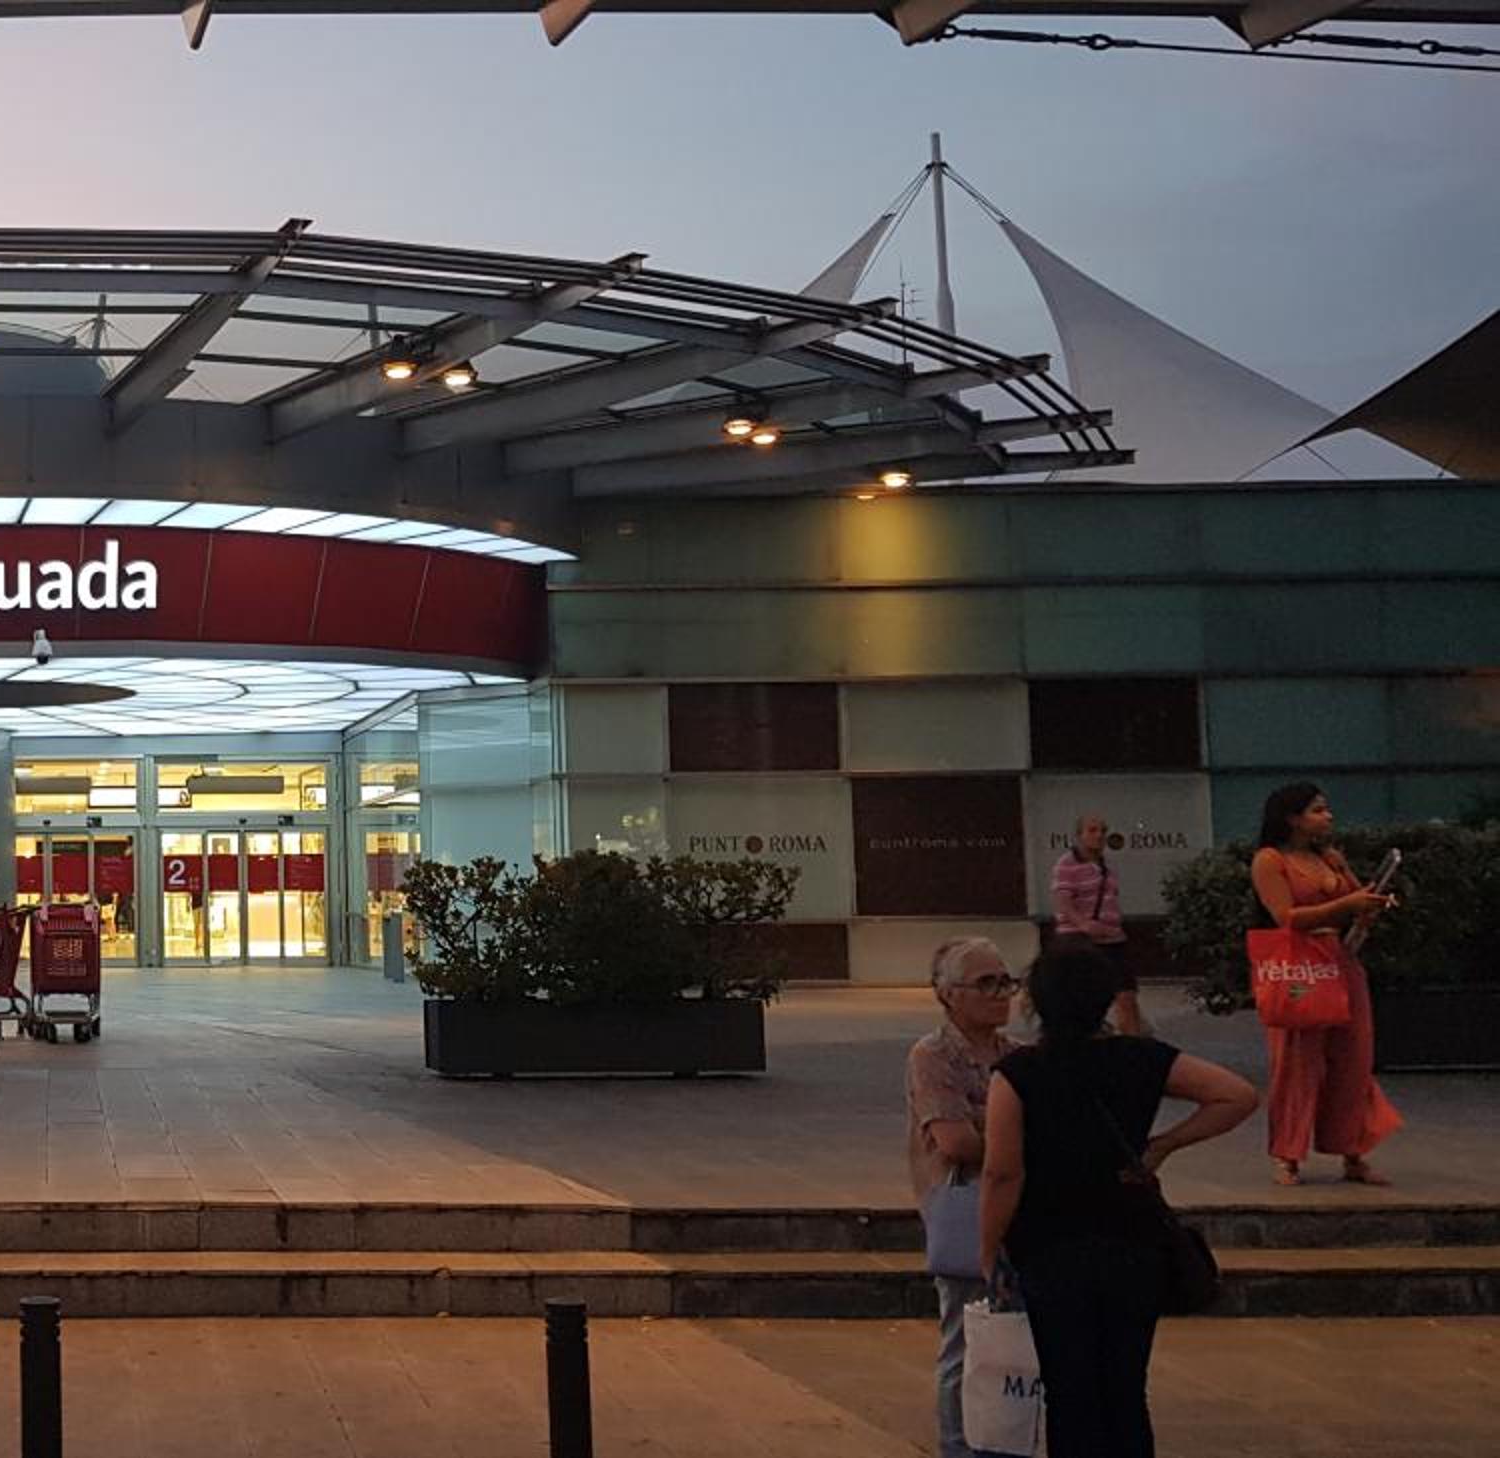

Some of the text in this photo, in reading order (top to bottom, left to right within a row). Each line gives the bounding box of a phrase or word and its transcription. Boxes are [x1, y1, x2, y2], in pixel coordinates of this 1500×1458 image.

[769, 835, 827, 853] ROMA
[1130, 832, 1189, 849] ROMA
[168, 859, 186, 885] 2
[1258, 959, 1340, 985] rebajas
